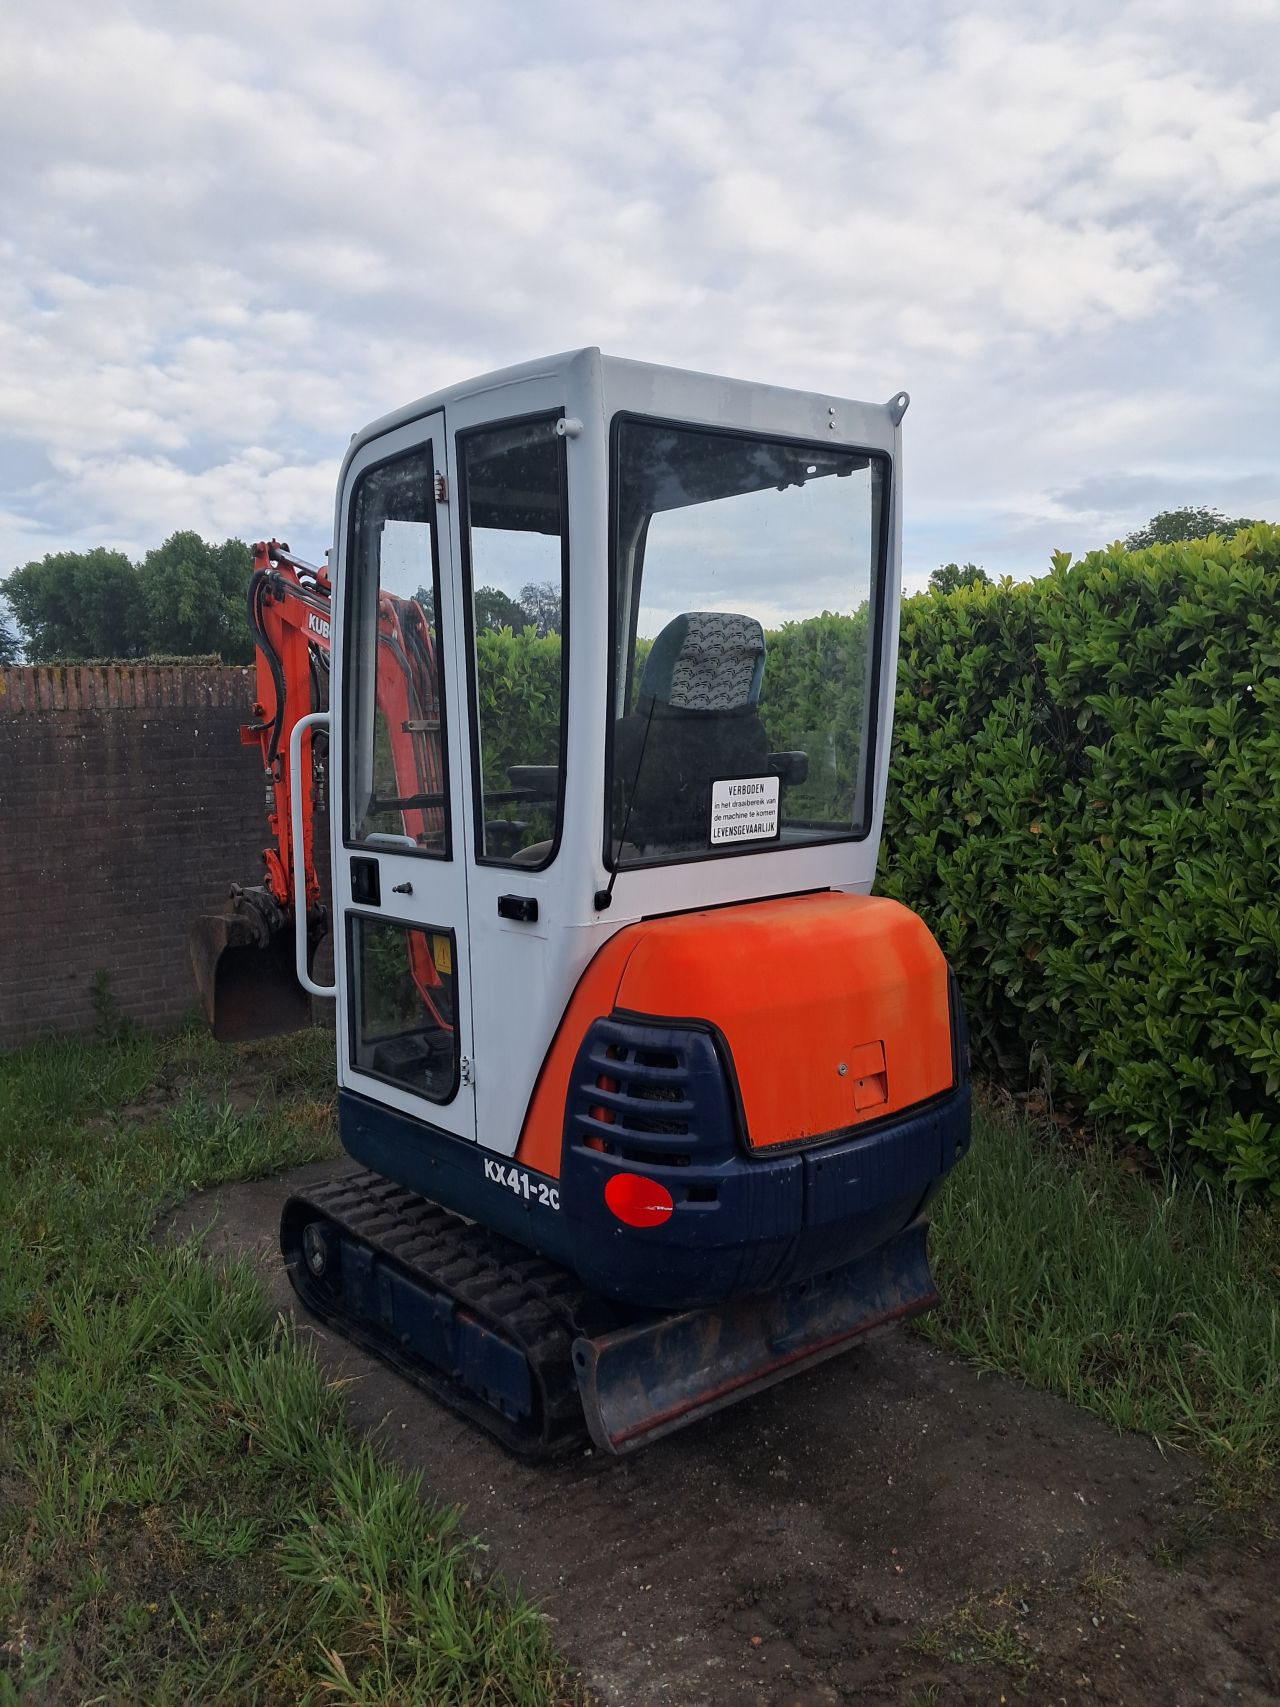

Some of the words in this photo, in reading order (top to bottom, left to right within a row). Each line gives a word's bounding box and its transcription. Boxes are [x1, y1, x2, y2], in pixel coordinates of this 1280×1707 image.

[308, 612, 331, 639] KUB
[728, 783, 765, 796] VERBODEN
[721, 801, 731, 809] het
[731, 798, 765, 808] draaibereik
[722, 811, 748, 820] machine
[756, 809, 776, 817] komen
[713, 822, 775, 838] LEVENSGEVAARLIJK
[484, 1158, 560, 1210] KX41-2C
